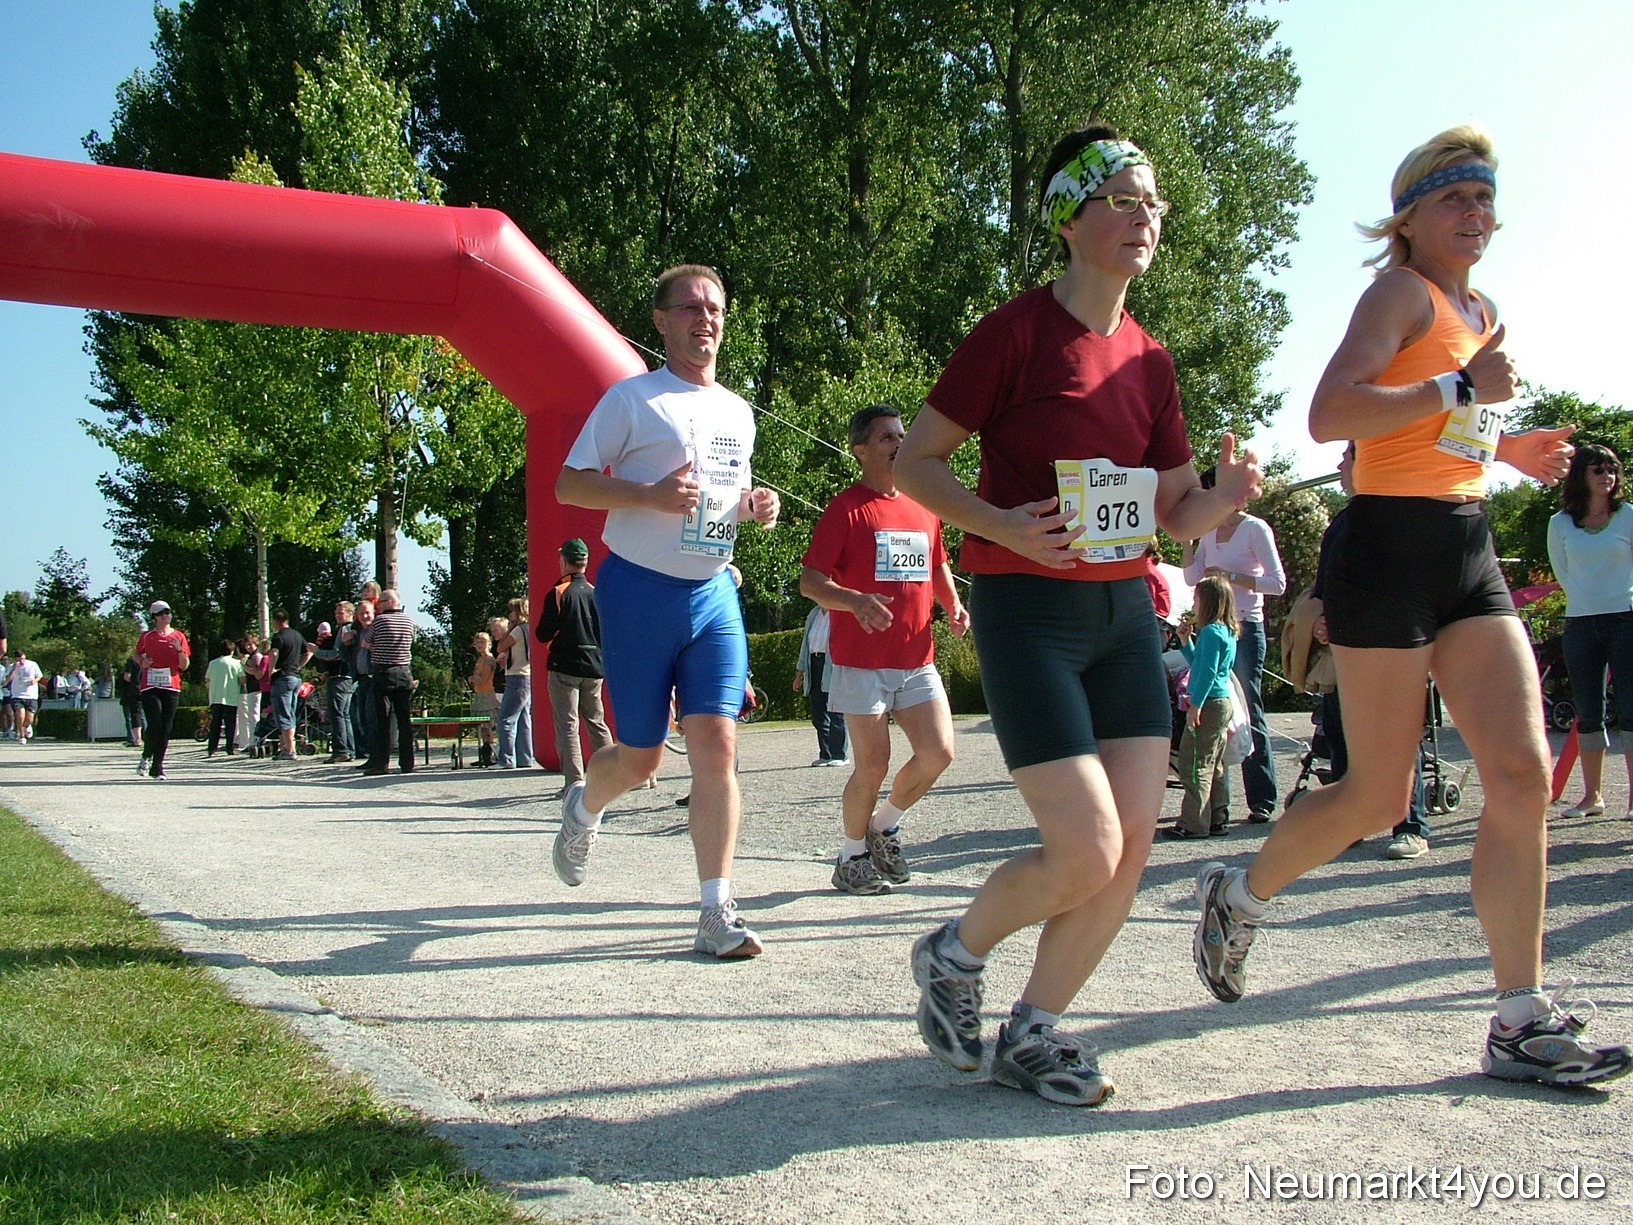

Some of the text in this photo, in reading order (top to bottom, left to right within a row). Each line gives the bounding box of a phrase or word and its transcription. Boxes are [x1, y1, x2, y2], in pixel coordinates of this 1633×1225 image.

[700, 467, 741, 479] Neumarkte
[1089, 468, 1127, 487] Caren
[706, 498, 723, 511] Rolf
[1096, 501, 1140, 532] 978
[890, 536, 911, 546] Bernd
[892, 554, 925, 567] 2206
